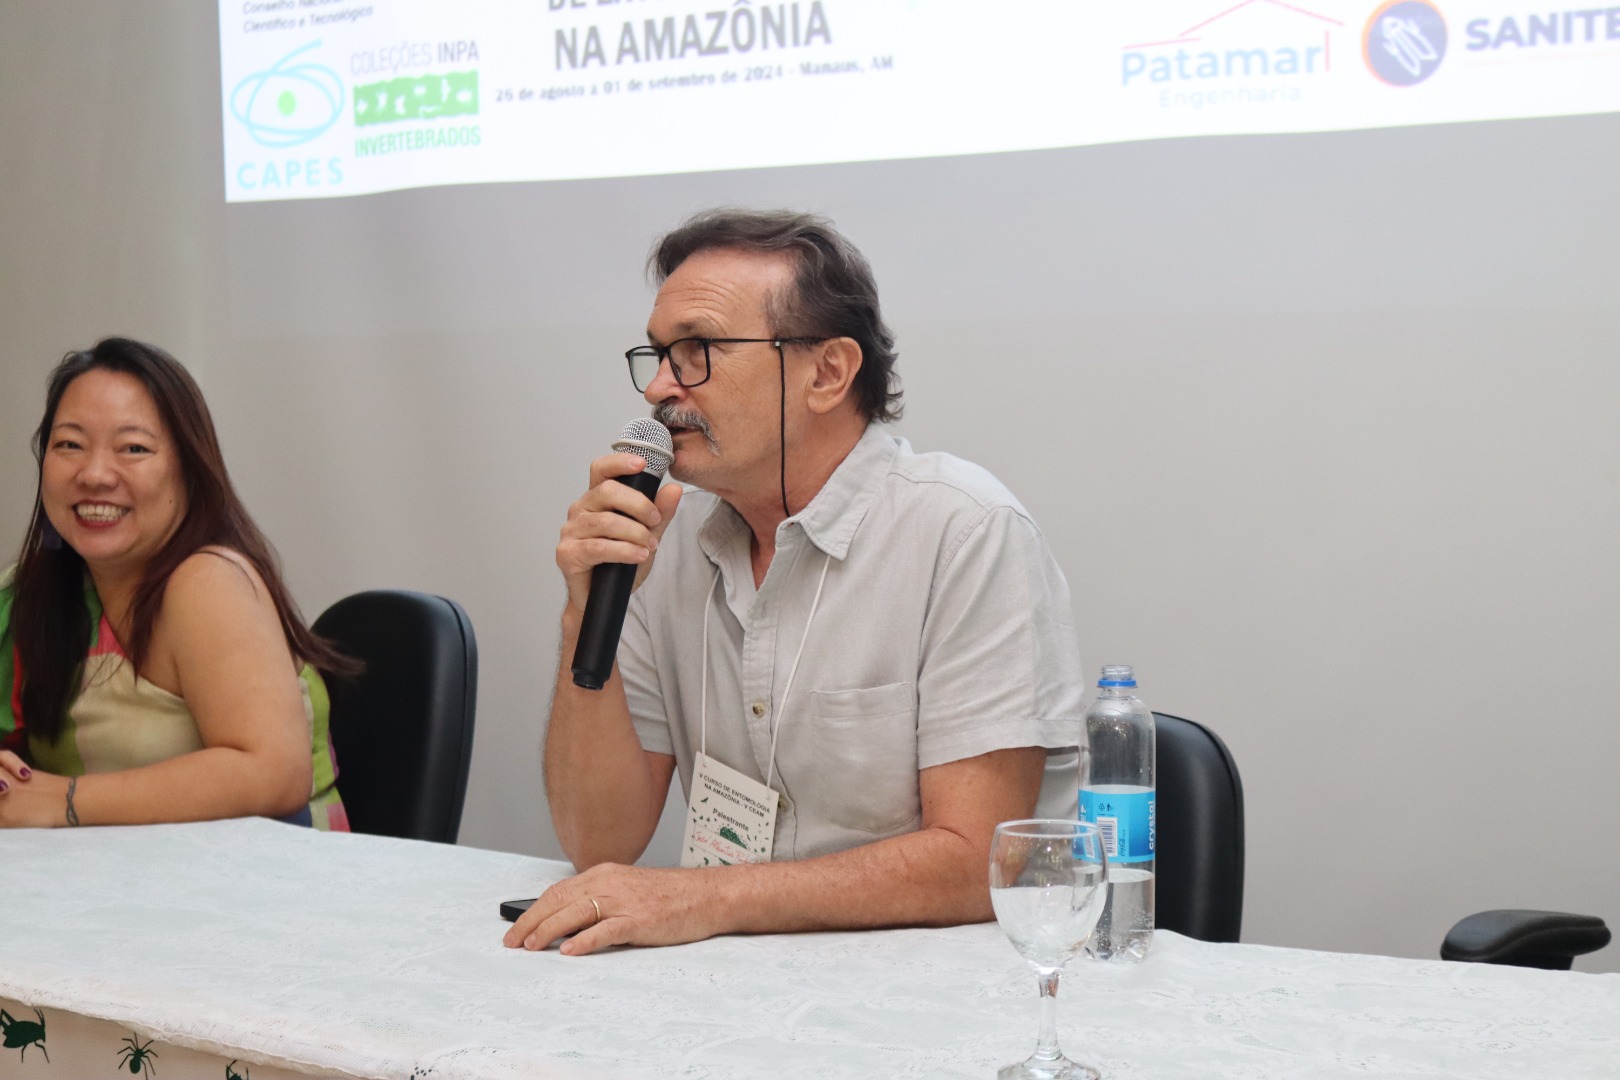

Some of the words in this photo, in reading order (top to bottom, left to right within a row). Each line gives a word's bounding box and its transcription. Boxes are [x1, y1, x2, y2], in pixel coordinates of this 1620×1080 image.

[299, 19, 306, 28] e
[310, 5, 374, 26] Tecnológico
[1466, 6, 1620, 51] SANITE
[554, 25, 607, 71] NA
[616, 0, 832, 65] AMAZÔNIA
[350, 42, 433, 75] COLEÇÕES
[437, 40, 480, 63] INPA
[1121, 45, 1322, 87] Patamar
[496, 87, 514, 102] 26
[519, 86, 534, 101] de
[540, 84, 585, 101] agosto
[590, 85, 598, 96] a
[604, 79, 620, 95] 01
[628, 77, 643, 92] de
[648, 72, 715, 90] setembro
[721, 69, 737, 84] de
[745, 63, 783, 81] 2024
[870, 55, 893, 71] AM
[1158, 83, 1302, 110] Engenharia
[355, 126, 482, 157] INVERTEBRADOS
[236, 157, 344, 190] CAPES
[703, 774, 723, 788] CURSO
[731, 789, 770, 813] ENTOMOLOGIA
[704, 782, 712, 791] NA
[712, 787, 741, 806] AMAZÔNIA
[748, 806, 765, 818] CEAM
[712, 808, 749, 831] Palestrante
